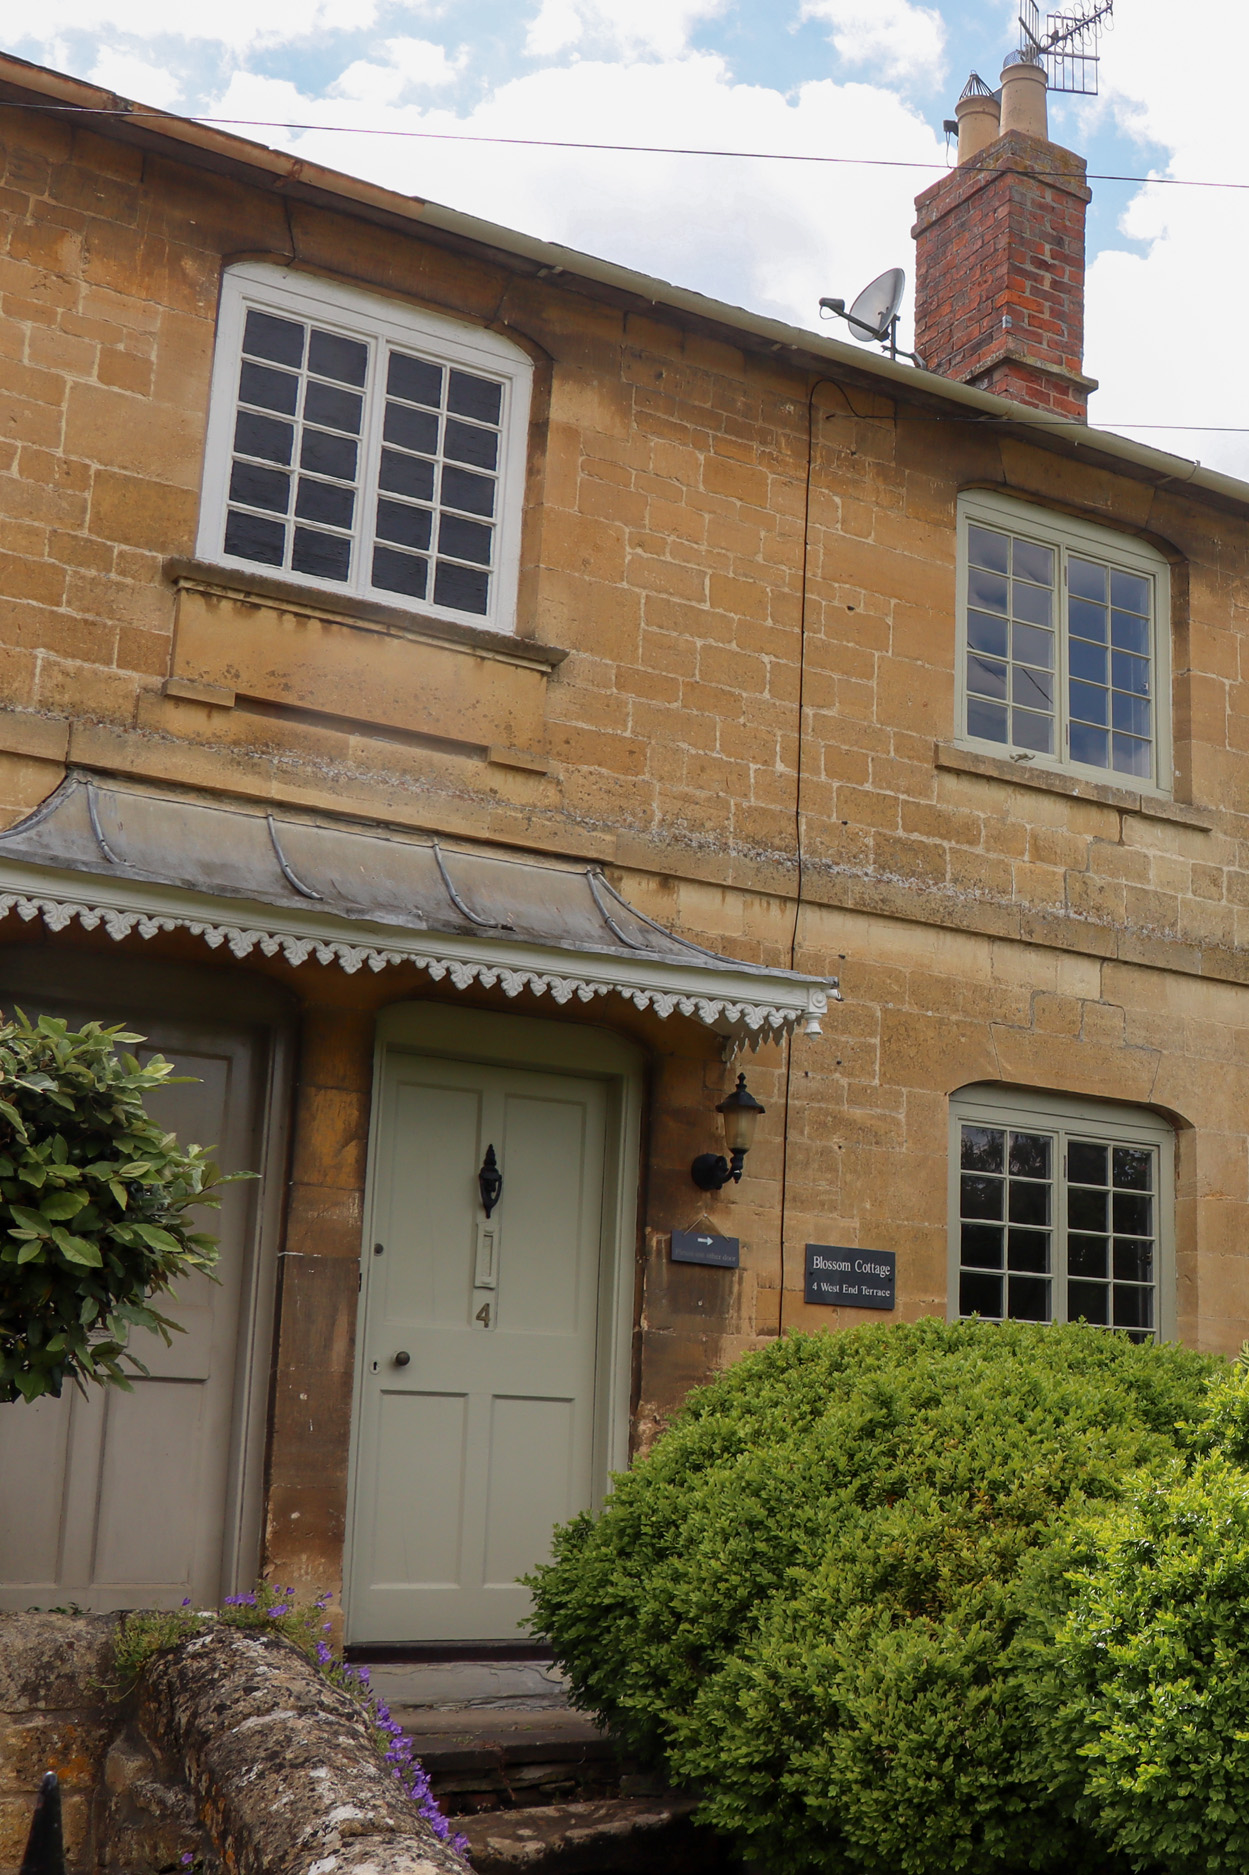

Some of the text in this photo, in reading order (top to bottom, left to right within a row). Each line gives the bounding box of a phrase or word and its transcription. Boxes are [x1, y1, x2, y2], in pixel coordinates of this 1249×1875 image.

[722, 1254, 737, 1262] door
[813, 1256, 891, 1278] Blossom Cottage
[812, 1282, 891, 1297] 4 West End Terrace
[476, 1303, 490, 1328] 4
